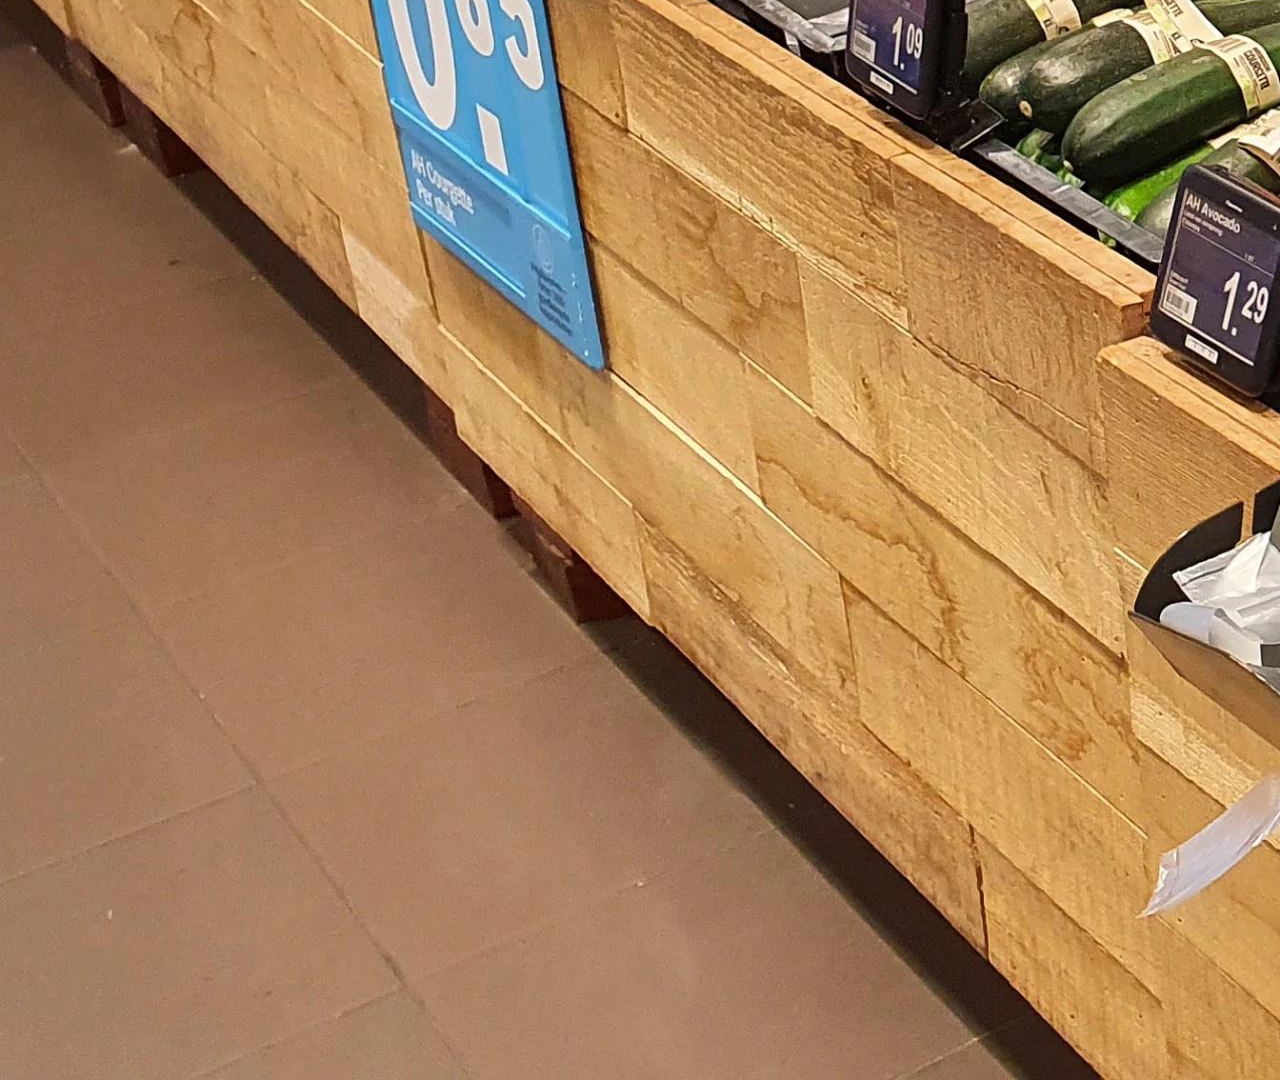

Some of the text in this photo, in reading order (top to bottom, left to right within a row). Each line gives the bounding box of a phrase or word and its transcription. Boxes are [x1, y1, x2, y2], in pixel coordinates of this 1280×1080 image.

[891, 15, 924, 71] 1.09
[415, 177, 434, 209] Per
[426, 160, 475, 216] Courgette
[1186, 193, 1202, 211] AH
[1201, 202, 1241, 234] Avocado
[1221, 270, 1270, 337] 1.29
